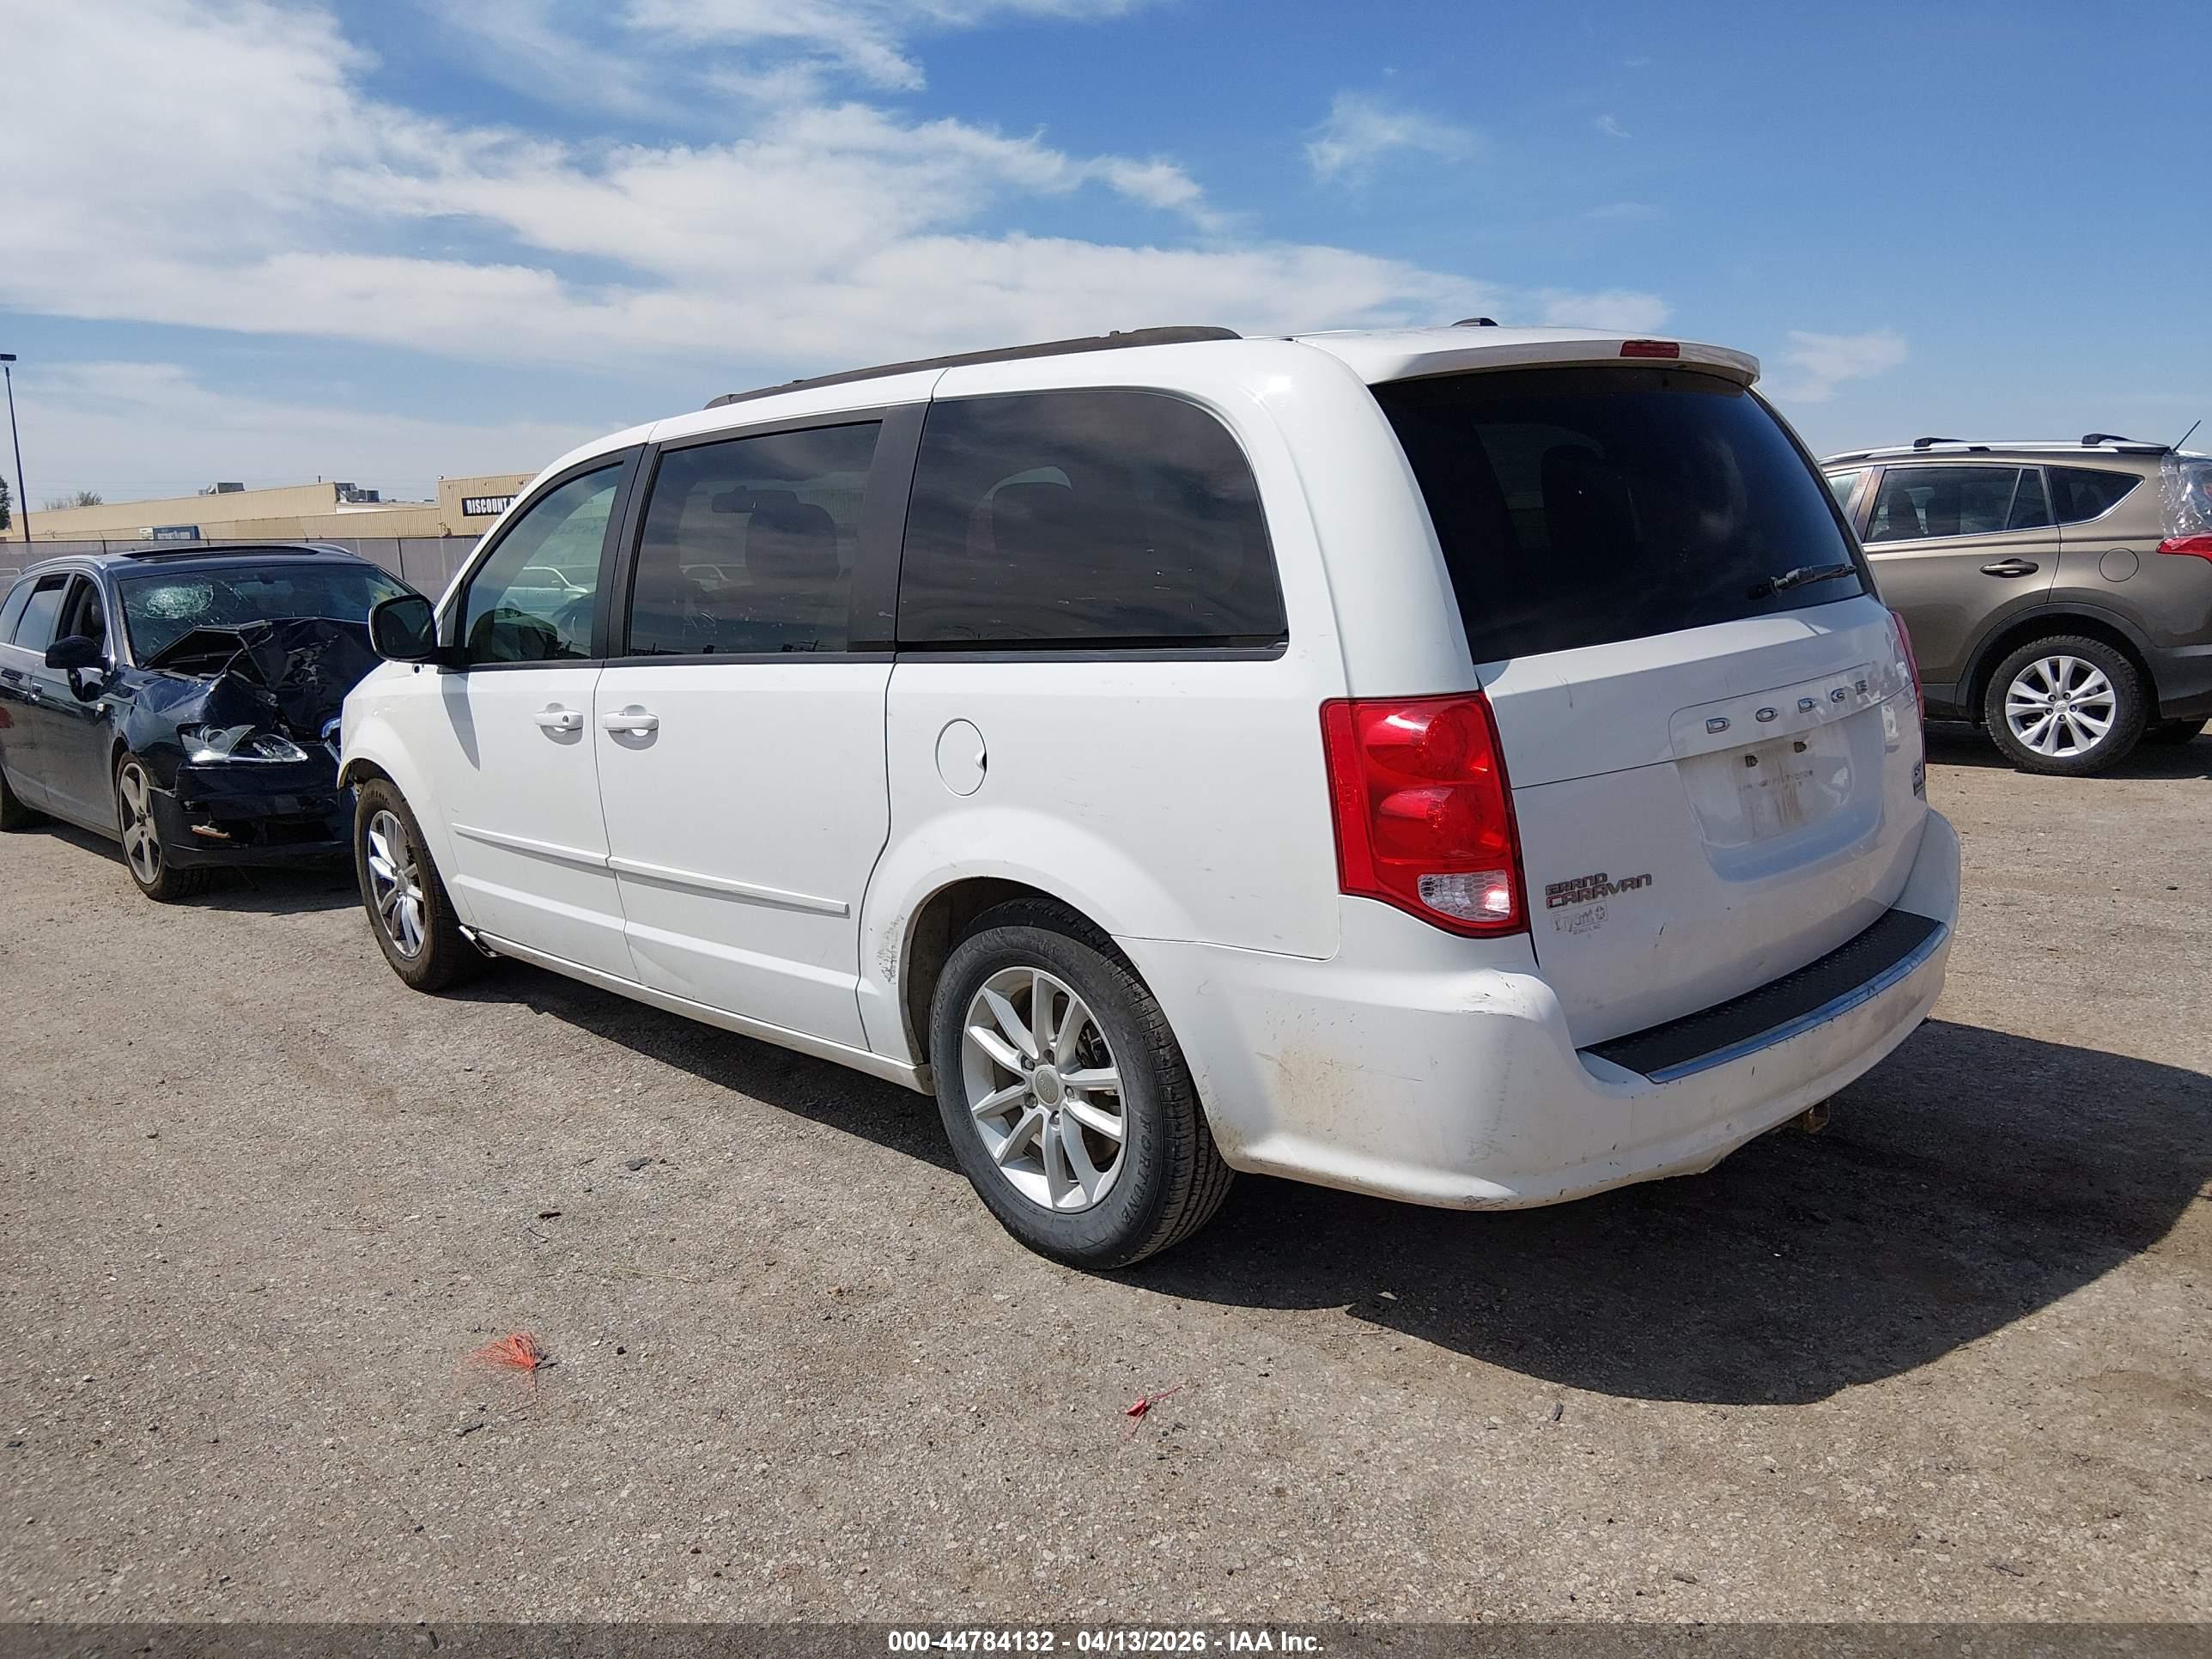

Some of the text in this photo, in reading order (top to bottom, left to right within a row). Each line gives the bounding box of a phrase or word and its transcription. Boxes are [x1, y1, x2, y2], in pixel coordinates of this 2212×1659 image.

[466, 497, 508, 514] DISCOUNT
[1705, 680, 1869, 734] DODGE
[1545, 872, 1608, 896] GRAND
[1546, 873, 1652, 909] CARAVAN
